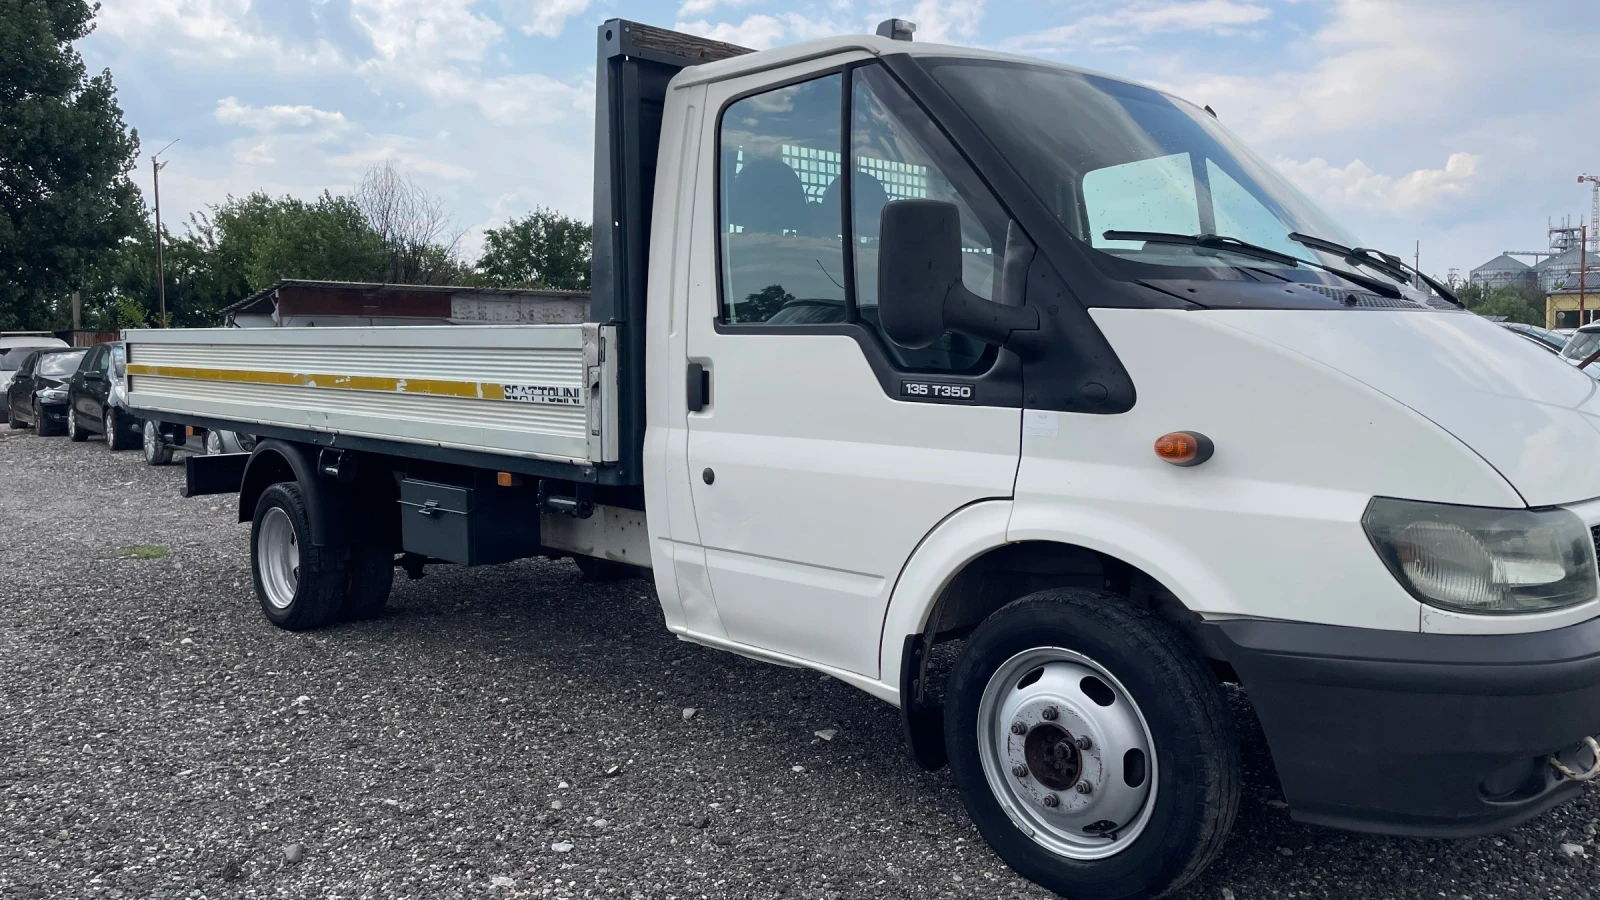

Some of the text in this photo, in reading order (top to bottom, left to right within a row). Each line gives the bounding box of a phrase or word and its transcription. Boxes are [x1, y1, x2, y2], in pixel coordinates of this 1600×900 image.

[504, 385, 580, 404] SCATTOLINI
[906, 384, 971, 398] 135 T350
